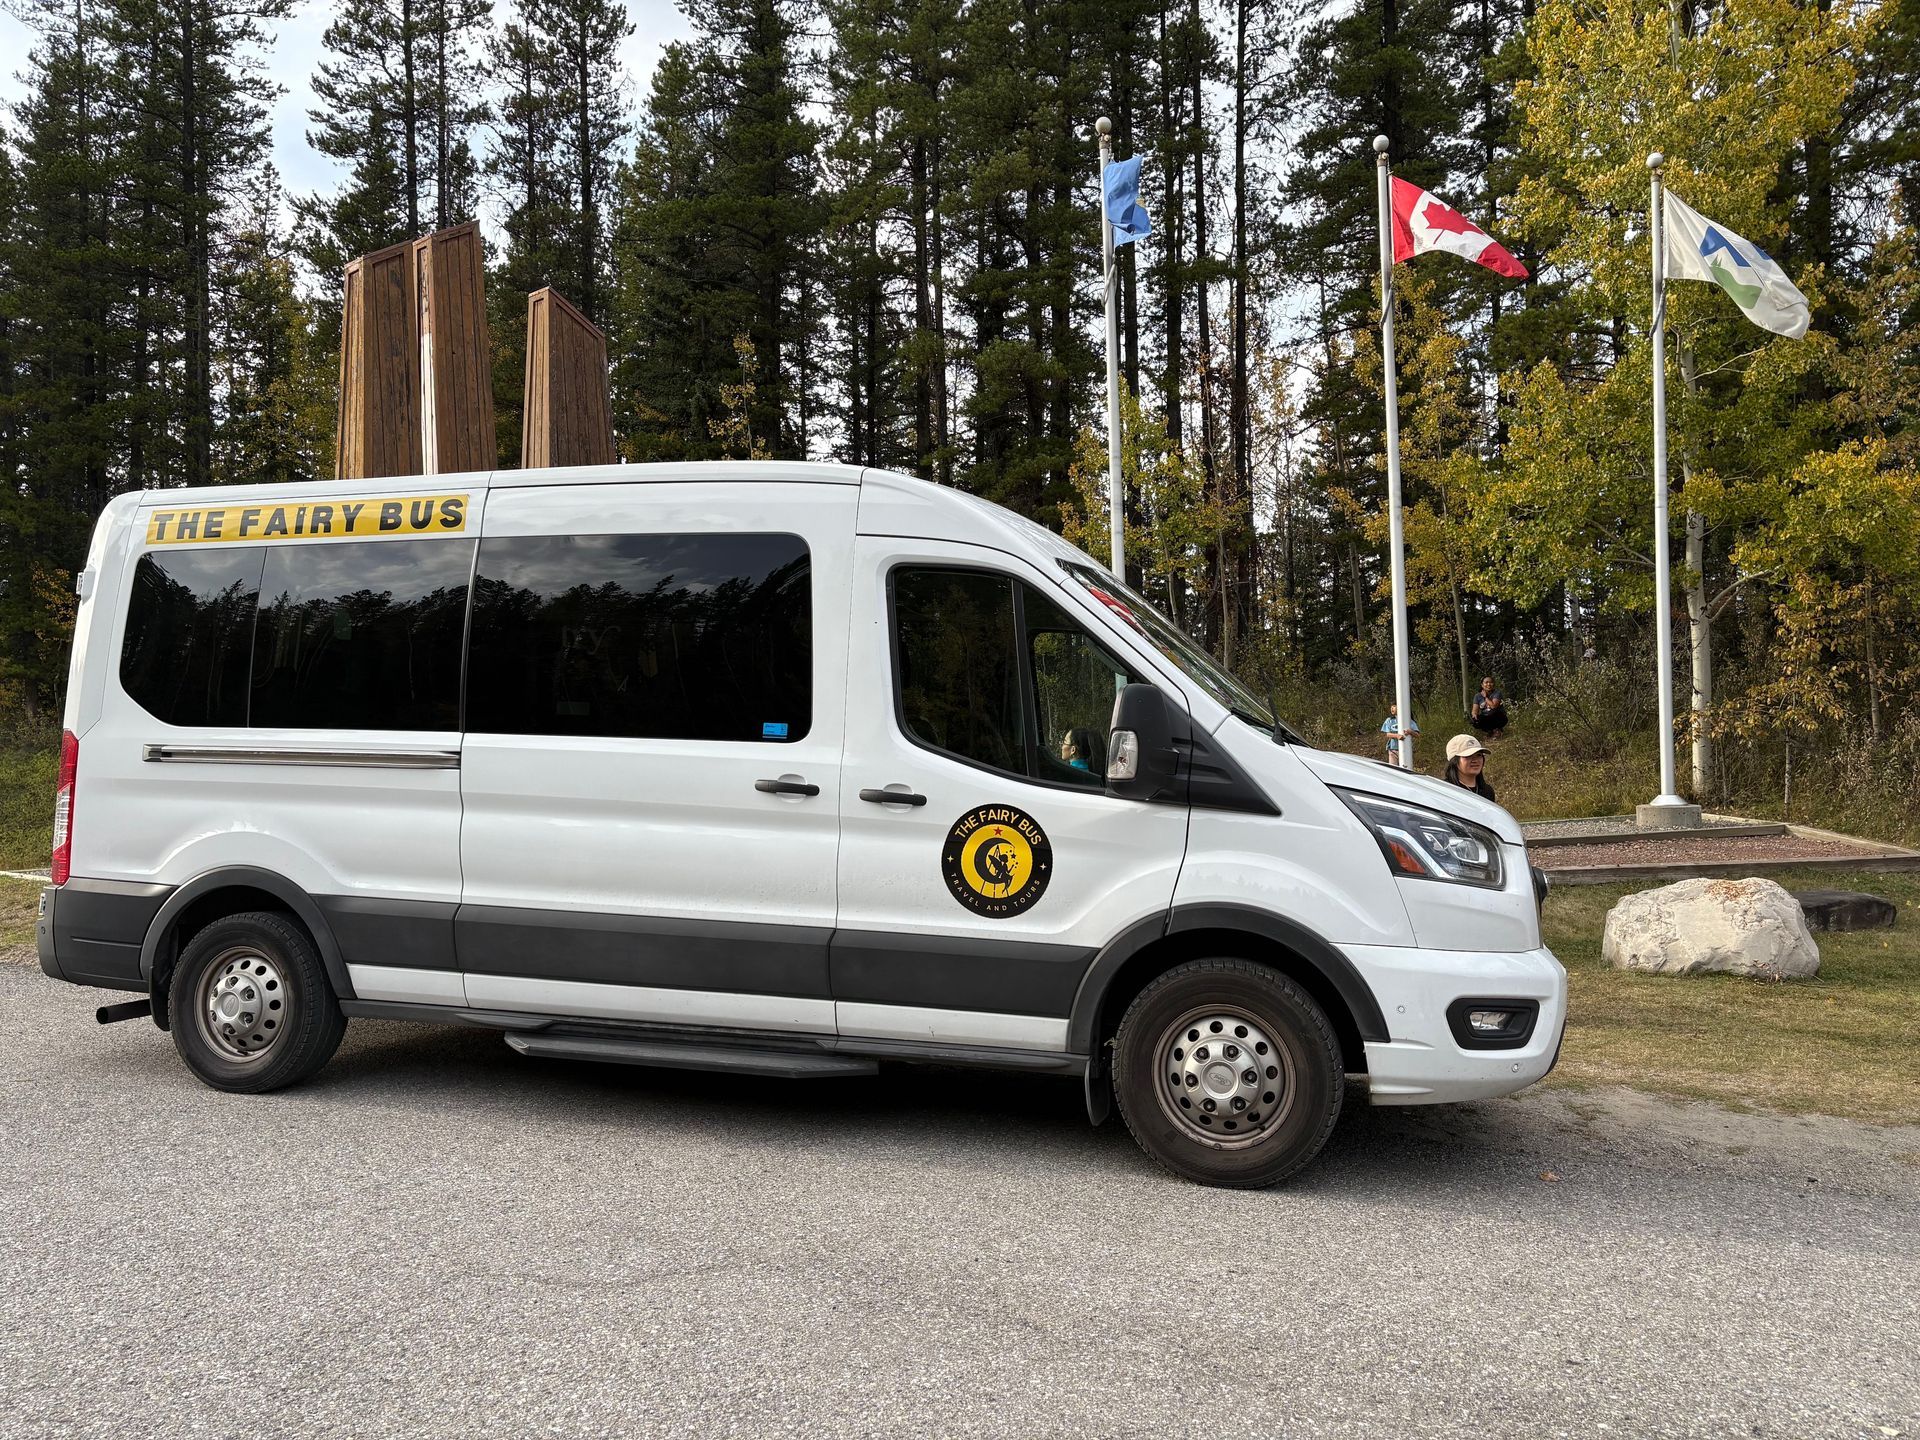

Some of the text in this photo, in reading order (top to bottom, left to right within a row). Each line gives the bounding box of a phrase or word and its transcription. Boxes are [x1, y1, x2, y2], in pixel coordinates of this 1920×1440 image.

[153, 498, 464, 540] THE FAIRY BUS
[954, 809, 1042, 845] THE FAIRY BUS
[951, 872, 980, 907] TRAVEL
[1013, 879, 1041, 907] TOURS
